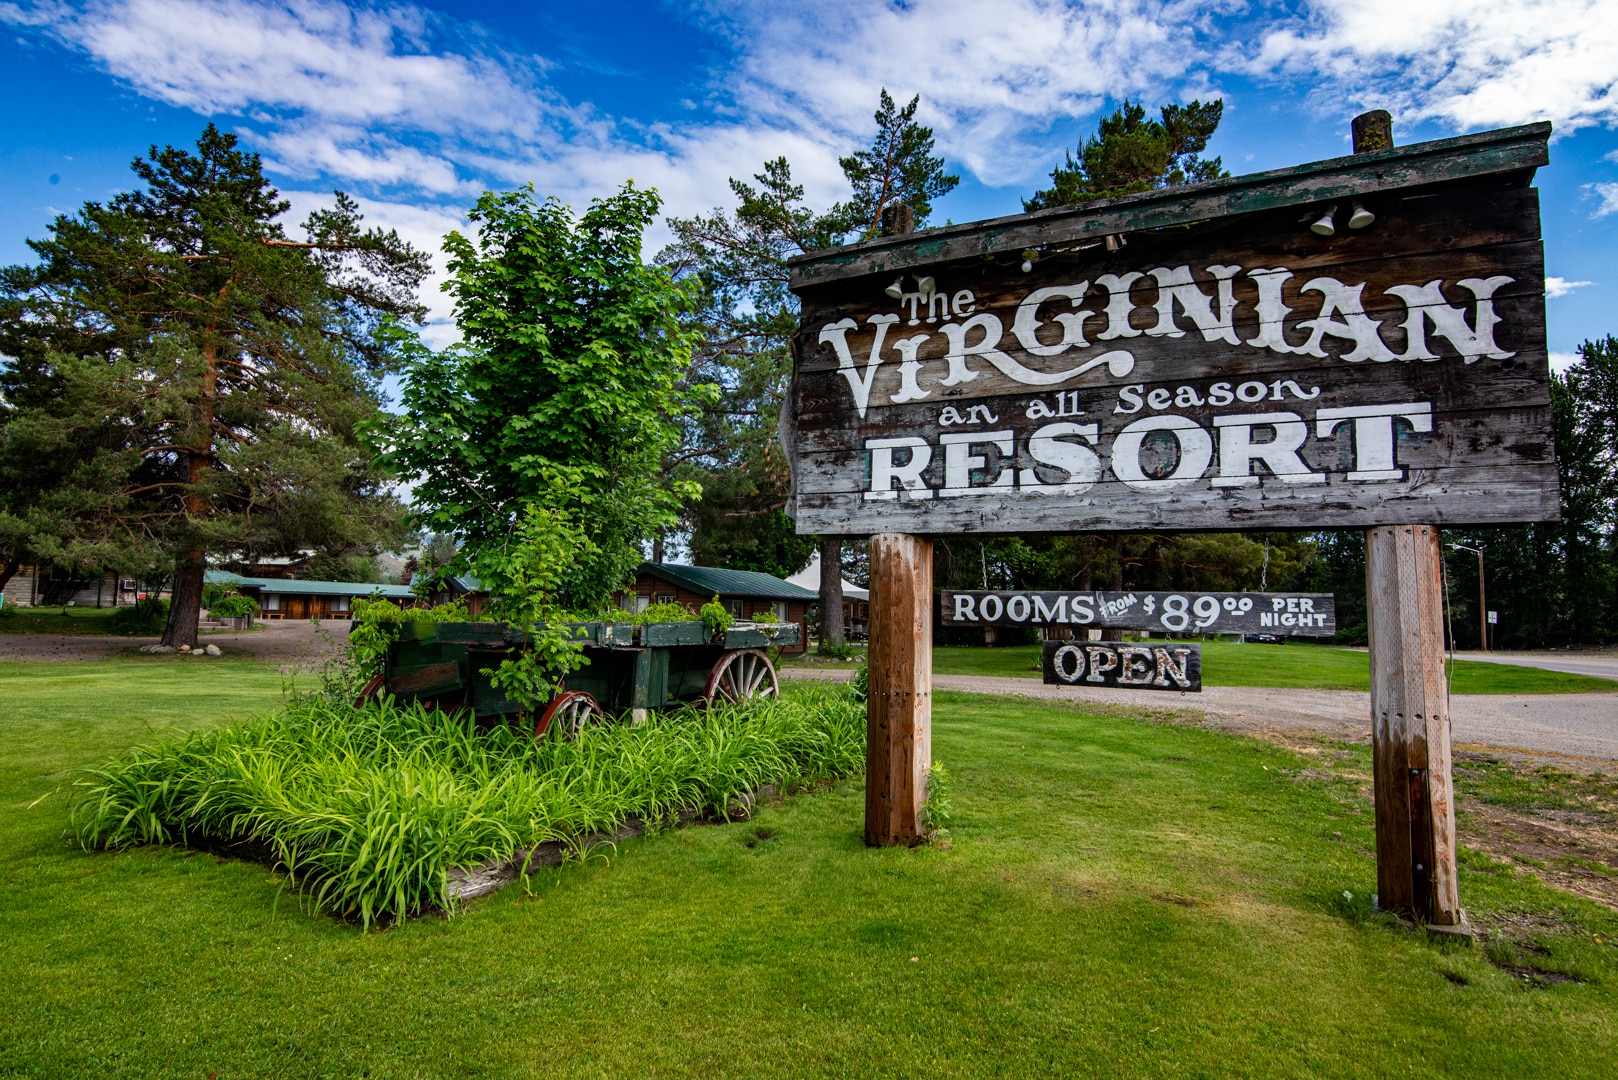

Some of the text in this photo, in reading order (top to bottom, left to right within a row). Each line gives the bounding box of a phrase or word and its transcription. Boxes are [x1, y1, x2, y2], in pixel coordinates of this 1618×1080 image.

[901, 289, 976, 326] The
[938, 379, 1320, 426] an all Season
[864, 402, 1433, 500] RESORT
[953, 594, 1095, 624] ROOMS
[1271, 598, 1314, 613] PER
[1260, 612, 1327, 628] NIGHT
[1053, 645, 1191, 688] OPEN
